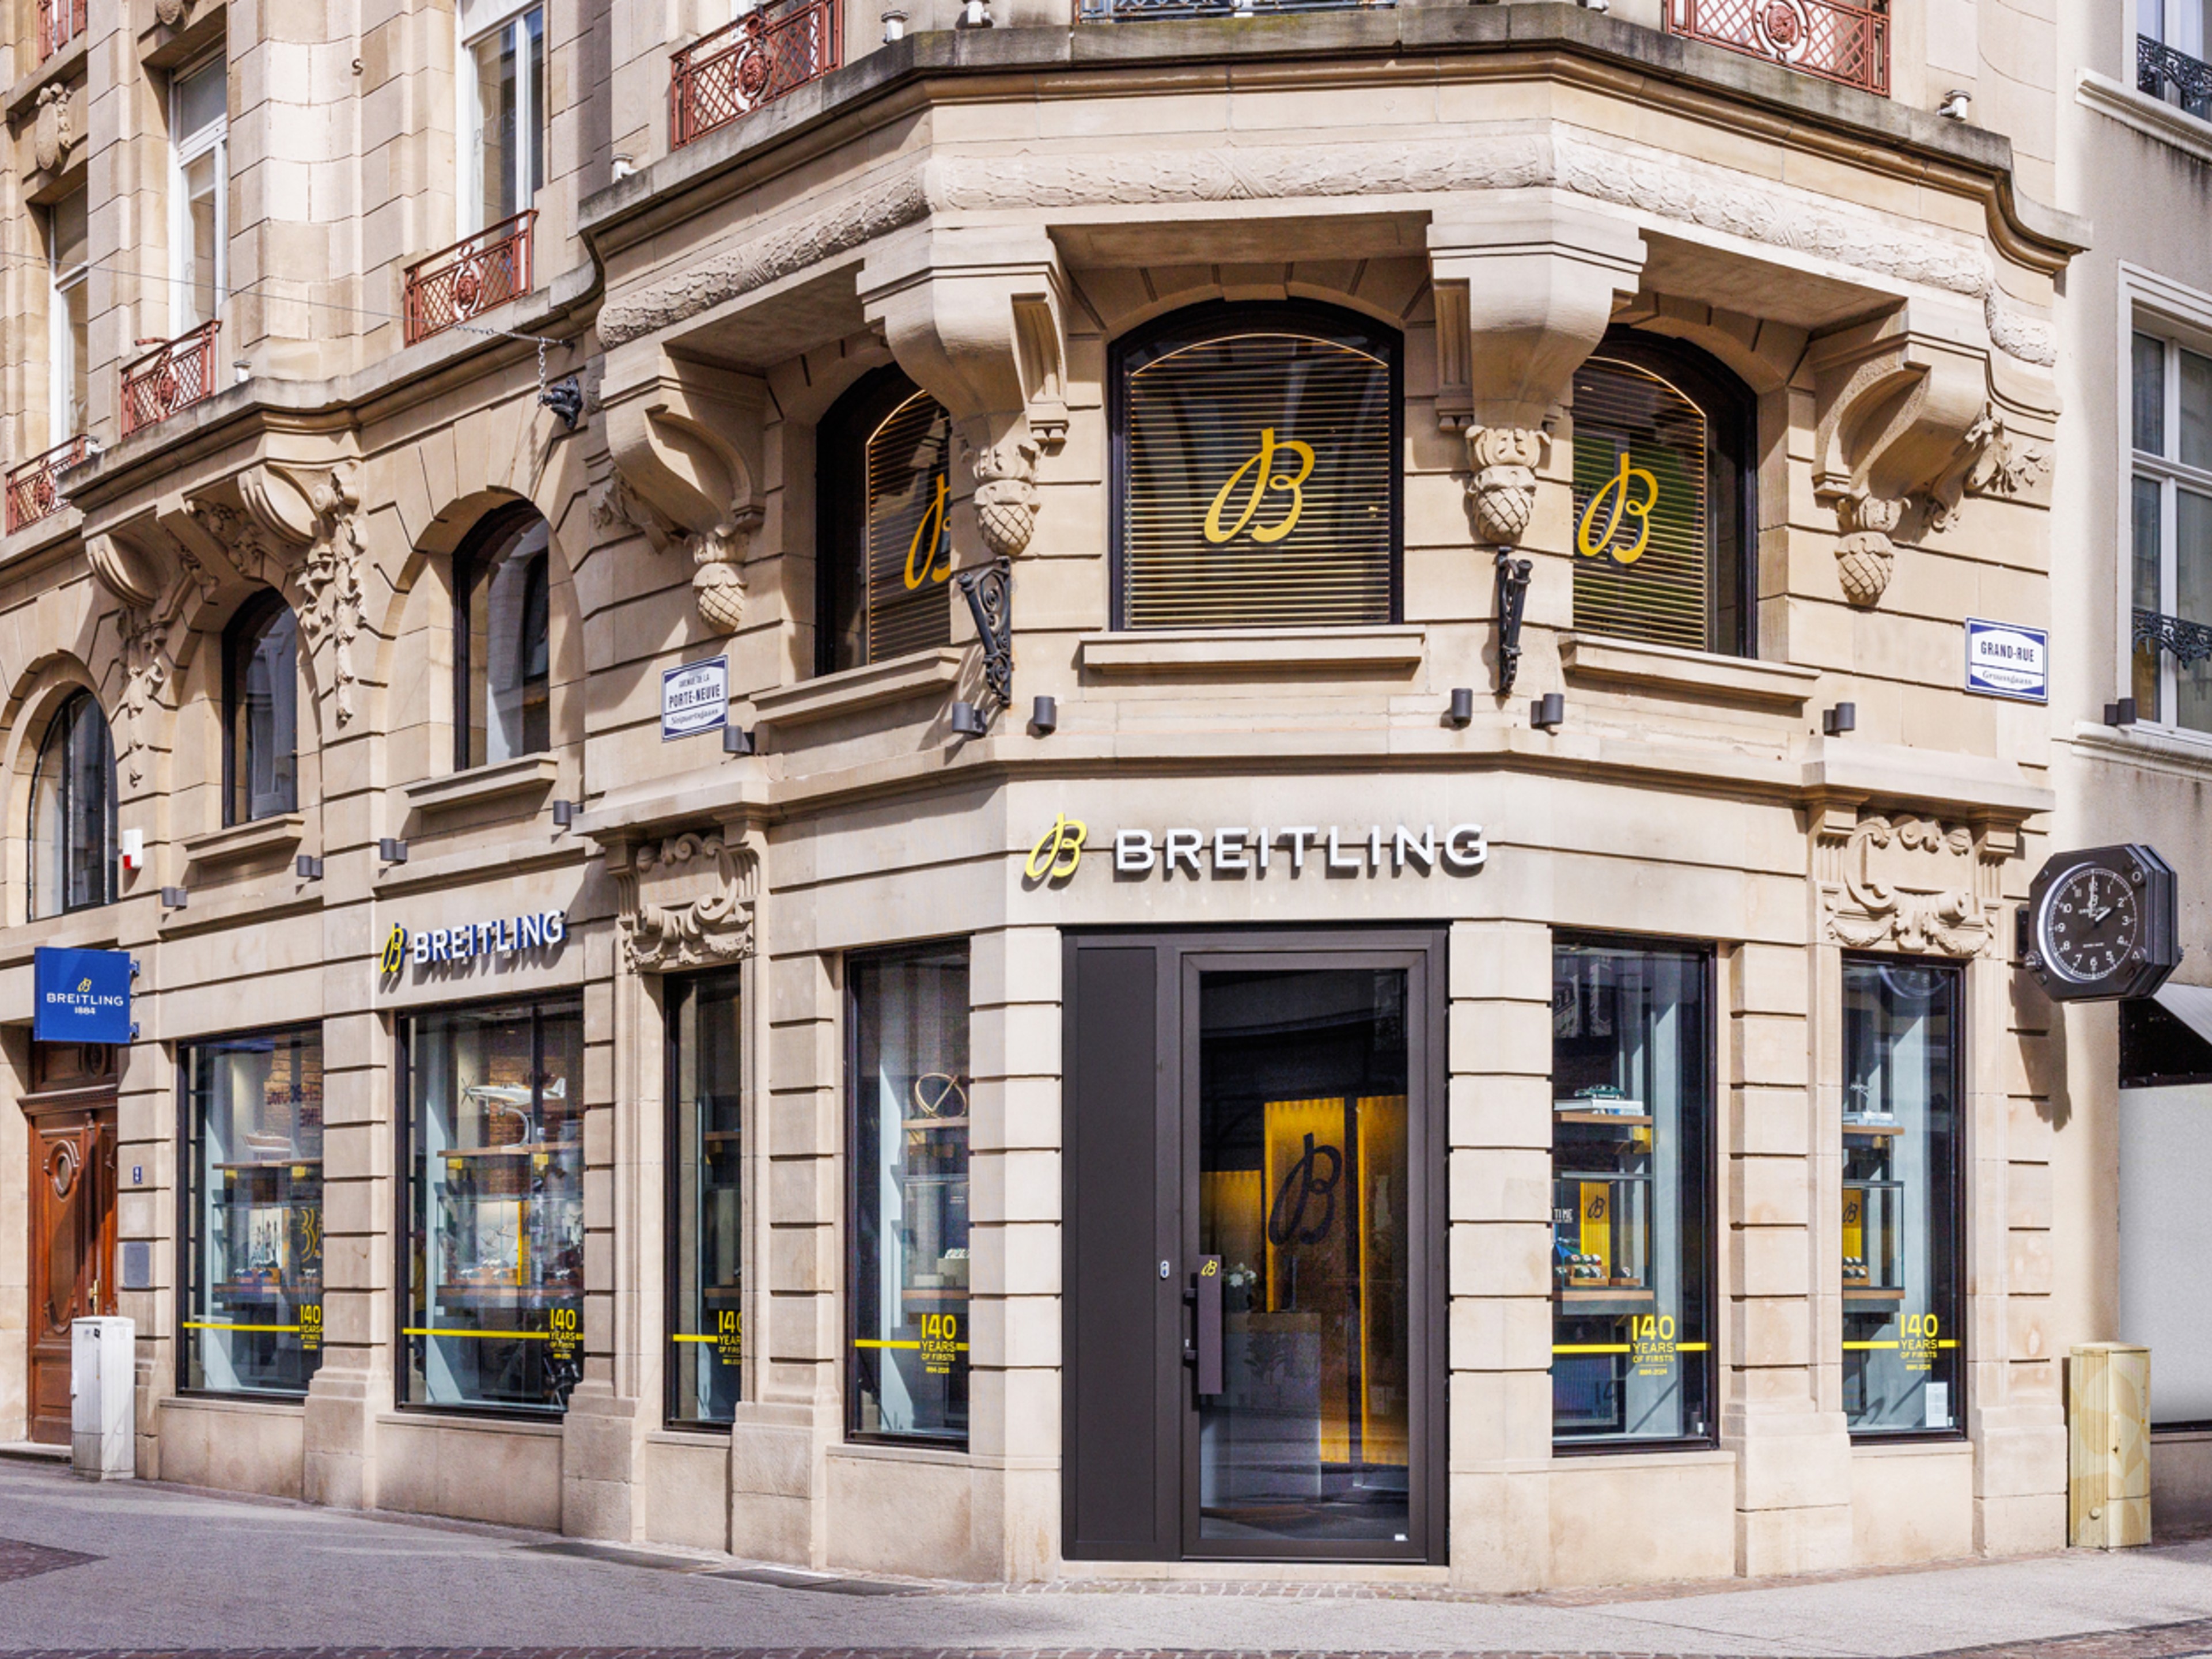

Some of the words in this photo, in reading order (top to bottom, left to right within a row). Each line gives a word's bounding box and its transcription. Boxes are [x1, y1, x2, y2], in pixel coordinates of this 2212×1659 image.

[1980, 641, 2035, 662] GRAND-RUE
[703, 673, 710, 681] LA
[669, 684, 720, 709] PORTE-NEUVE
[1115, 823, 1488, 870] BREITLING
[2118, 897, 2125, 908] 2
[2063, 904, 2073, 914] 10
[2122, 915, 2130, 925] 3
[2058, 922, 2066, 932] 9
[414, 909, 566, 964] BREITLING
[2117, 935, 2124, 945] 4
[2063, 940, 2070, 950] 8
[2075, 953, 2082, 963] 7
[2090, 957, 2098, 967] 6
[47, 992, 124, 1006] BREITLING
[301, 1305, 321, 1324] 140
[551, 1308, 577, 1331] 140
[922, 1314, 957, 1340] 140
[1633, 1314, 1675, 1342] 140
[1900, 1313, 1938, 1338] 140
[718, 1335, 741, 1346] YEAR
[1900, 1339, 1937, 1350] YEARS
[922, 1340, 956, 1353] YEARS
[1633, 1343, 1675, 1354] YEARS
[1633, 1355, 1643, 1363] OF
[1645, 1355, 1675, 1363] FIRSTS
[1900, 1351, 1910, 1359] OF
